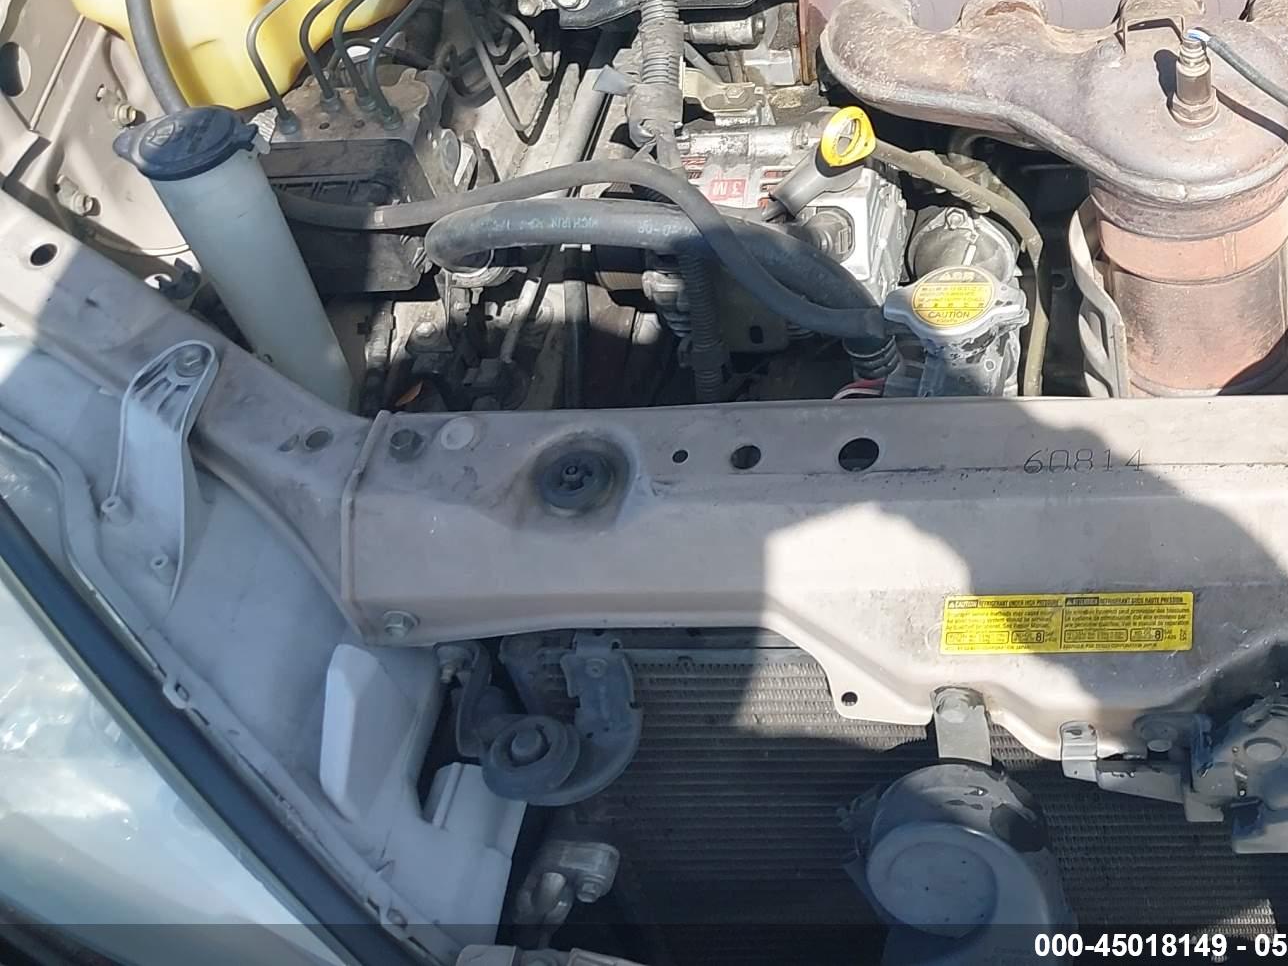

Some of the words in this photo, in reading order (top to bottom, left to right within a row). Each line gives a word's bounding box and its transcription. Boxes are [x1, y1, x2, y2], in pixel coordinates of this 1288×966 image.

[928, 311, 970, 319] CAUTION
[1035, 633, 1042, 641] 8
[1154, 630, 1162, 640] 8
